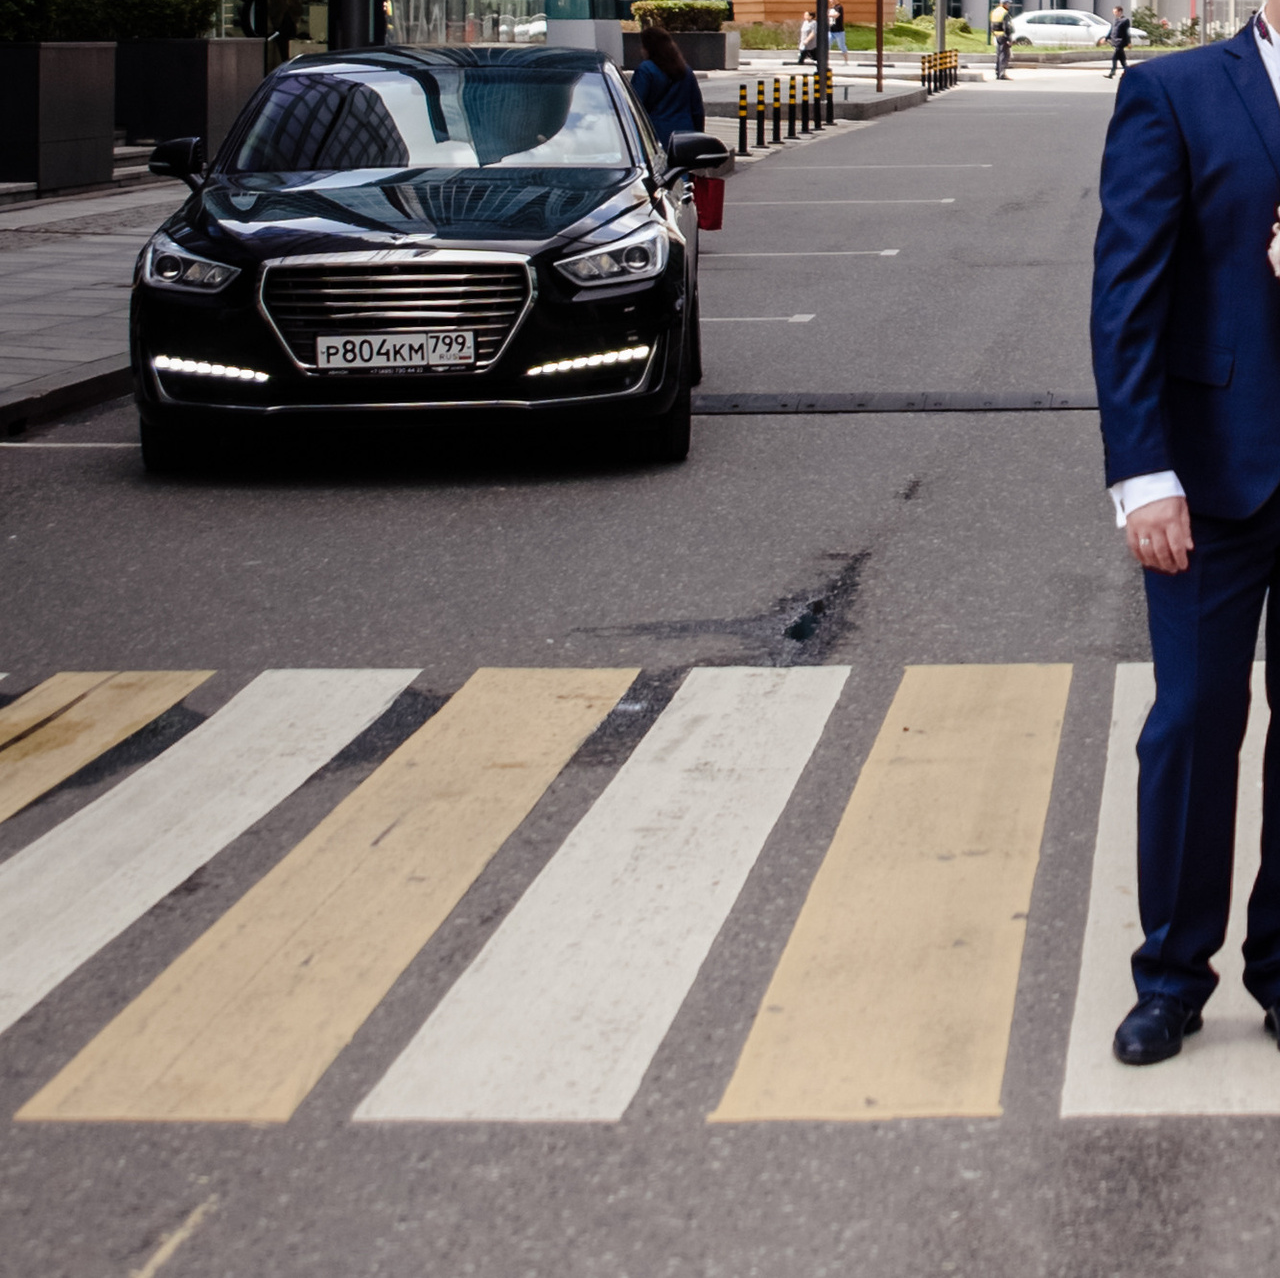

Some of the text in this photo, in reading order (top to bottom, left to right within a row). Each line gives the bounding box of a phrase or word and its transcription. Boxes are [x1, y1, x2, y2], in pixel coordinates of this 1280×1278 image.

[326, 334, 467, 364] Р804КМ 799
[439, 353, 458, 361] RUS
